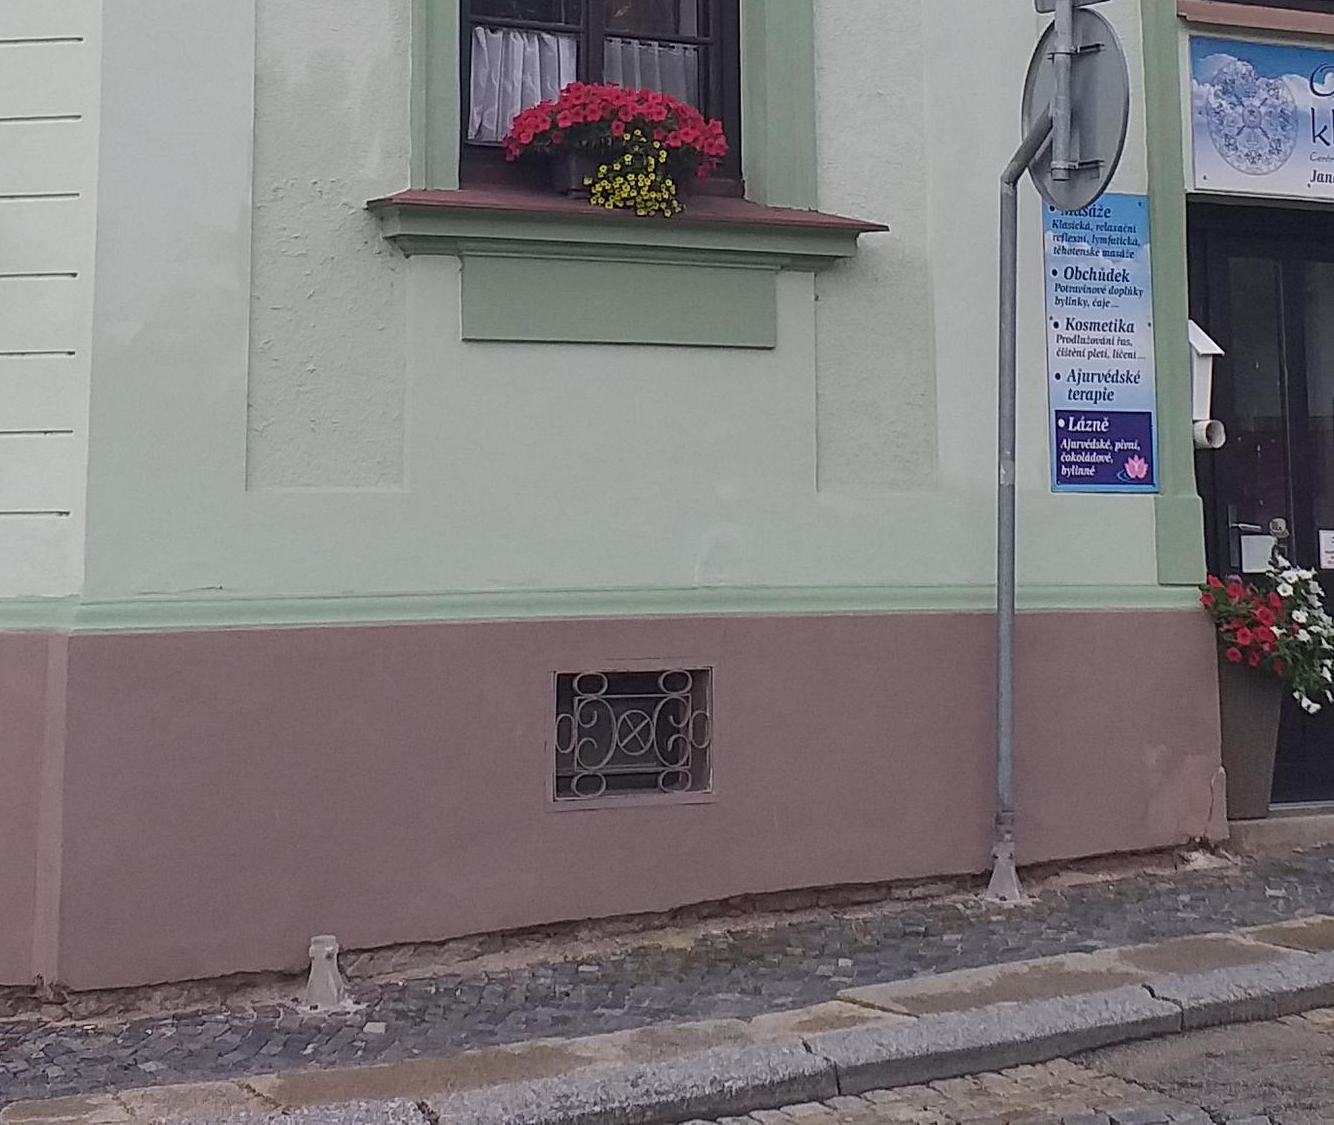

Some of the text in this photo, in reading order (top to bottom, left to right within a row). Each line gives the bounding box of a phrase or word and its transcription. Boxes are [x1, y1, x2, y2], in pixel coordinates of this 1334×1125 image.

[1051, 219, 1093, 231] Klasická,
[1052, 233, 1141, 247] reflexní, lymfatická,
[1053, 245, 1135, 259] těhotenské masáže
[1063, 265, 1130, 283] Obchůdek
[1054, 282, 1144, 299] Potravinové doplňky
[1054, 295, 1090, 309] bylinky,
[1065, 317, 1135, 333] Kosmetika
[1055, 334, 1133, 347] Prodlužování řas,
[1055, 347, 1086, 358] čištění
[1087, 349, 1110, 360] pleti,
[1066, 368, 1141, 386] Ajurvédské
[1067, 386, 1115, 405] terapie
[1067, 415, 1110, 432] Lázně
[1060, 438, 1141, 452] Ajurvédské, pivní,
[1060, 451, 1114, 463] čokoládové,
[1061, 464, 1096, 477] bylinné
